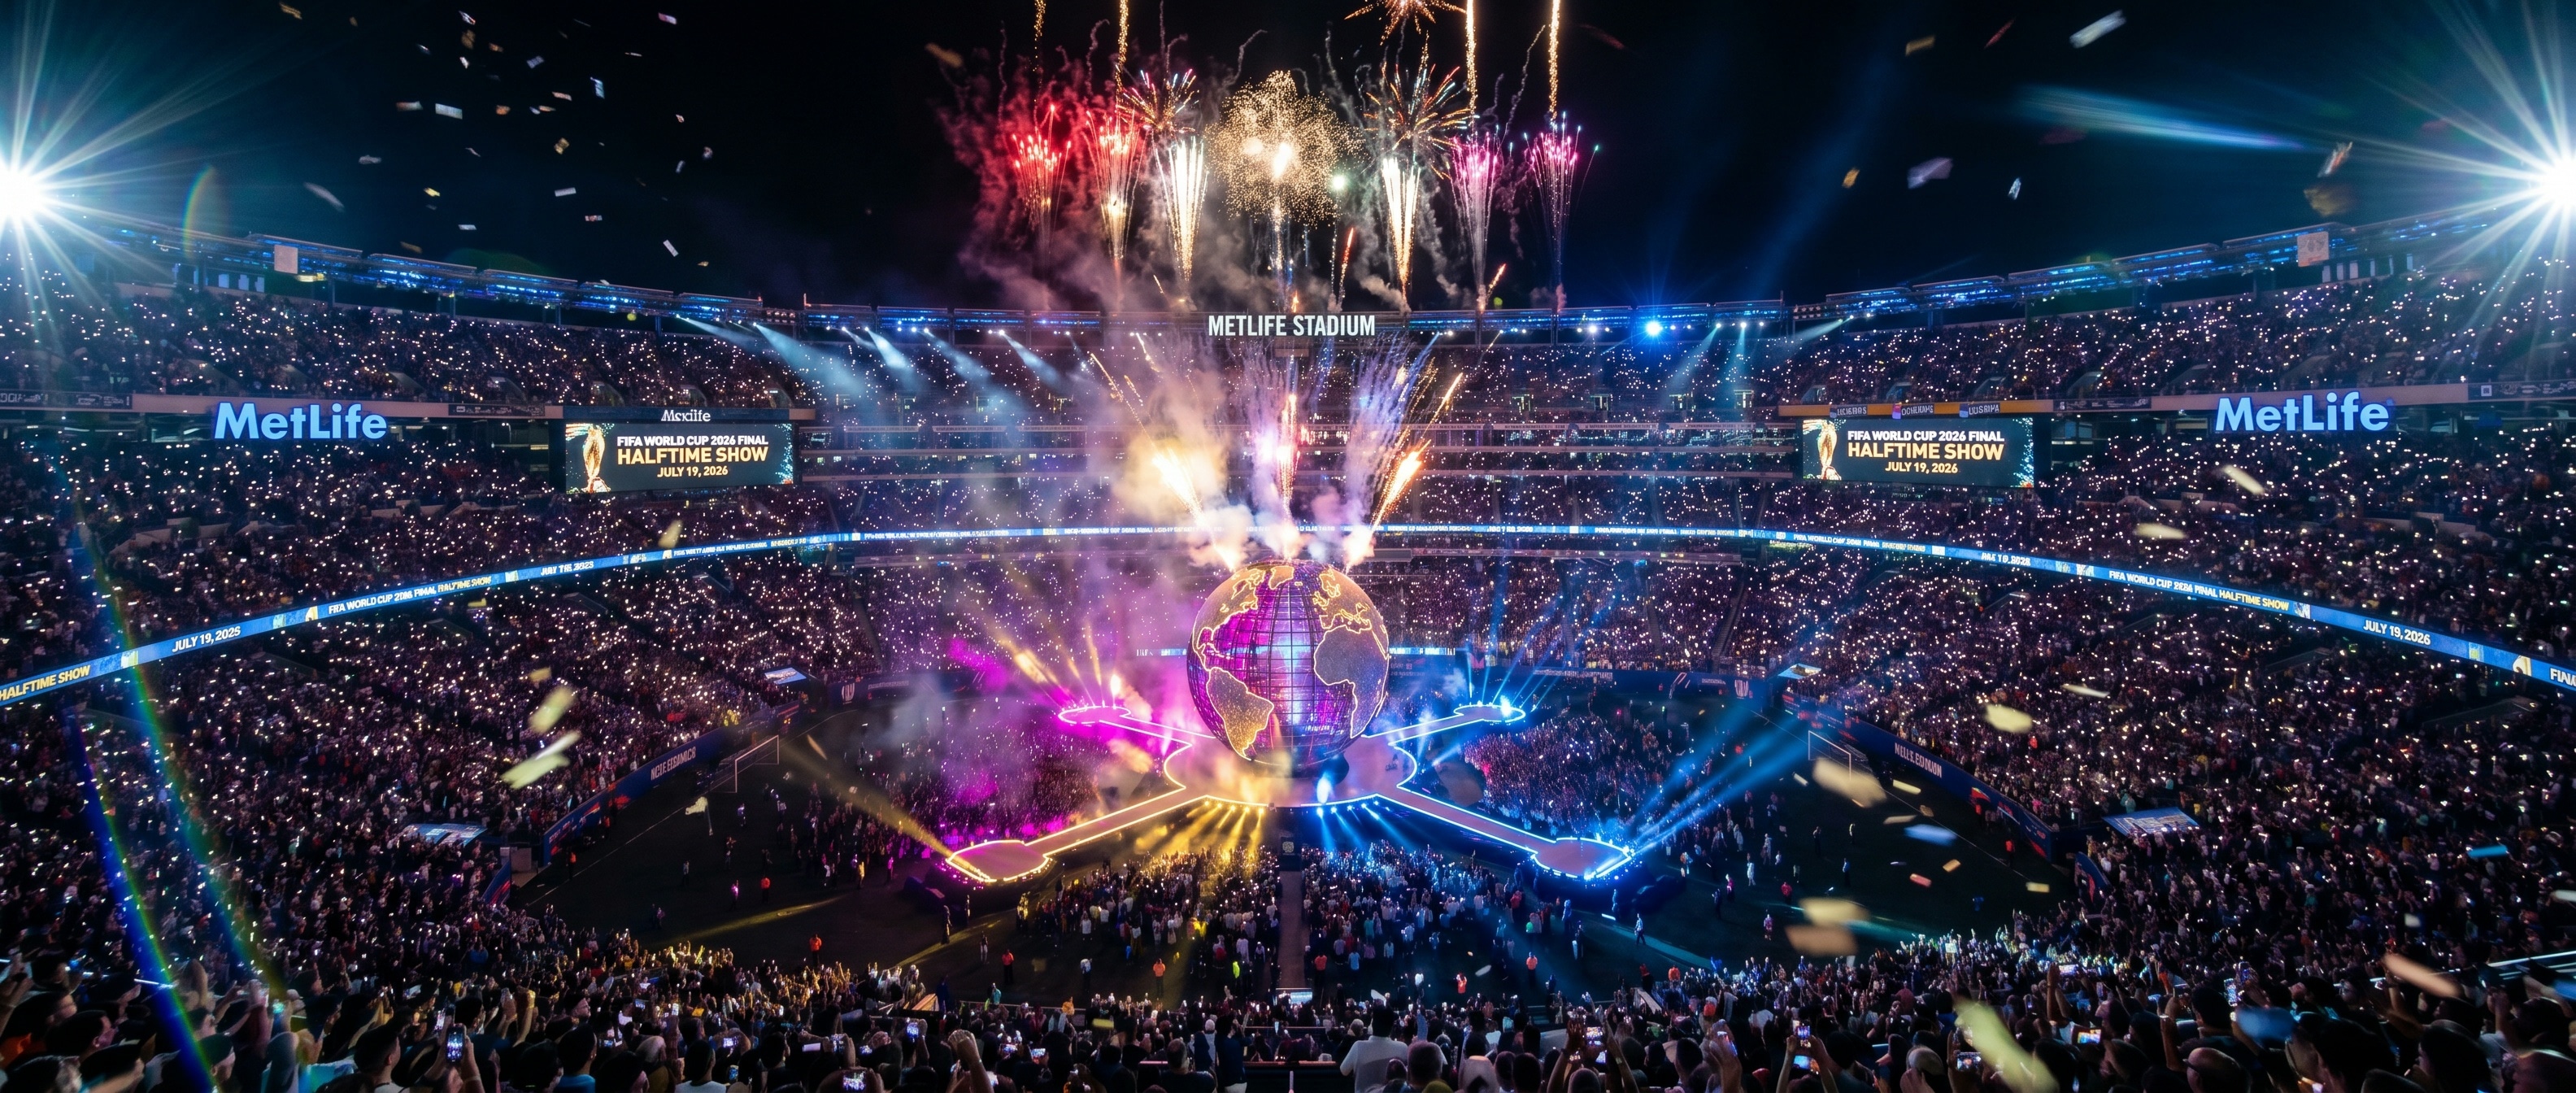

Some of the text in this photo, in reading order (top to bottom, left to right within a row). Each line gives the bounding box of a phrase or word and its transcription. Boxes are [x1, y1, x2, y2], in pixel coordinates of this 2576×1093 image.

[1208, 315, 1376, 337] METLIFE STADIUM
[2215, 391, 2390, 432] MetLife
[214, 402, 388, 440] MetLife
[616, 435, 768, 446] FIFA WORLD CUP 2026 FINAL
[1847, 430, 2005, 442] FIFA WORLD CUP 2026 FINAL
[617, 446, 769, 465] HALFTIME SHOW
[1847, 442, 2004, 461] HALFTIME SHOW
[657, 465, 729, 478] JULY 19, 2026
[1885, 461, 1959, 475] JULY 19, 2026
[2126, 573, 2156, 586] WORLD
[2156, 578, 2173, 590] CUP
[346, 597, 377, 611] WORLD
[376, 594, 394, 605] CUP
[2363, 619, 2388, 635] JULY
[2404, 629, 2431, 646] 2026
[172, 635, 198, 653] JULY
[0, 664, 91, 701] HALFTIME SHOW
